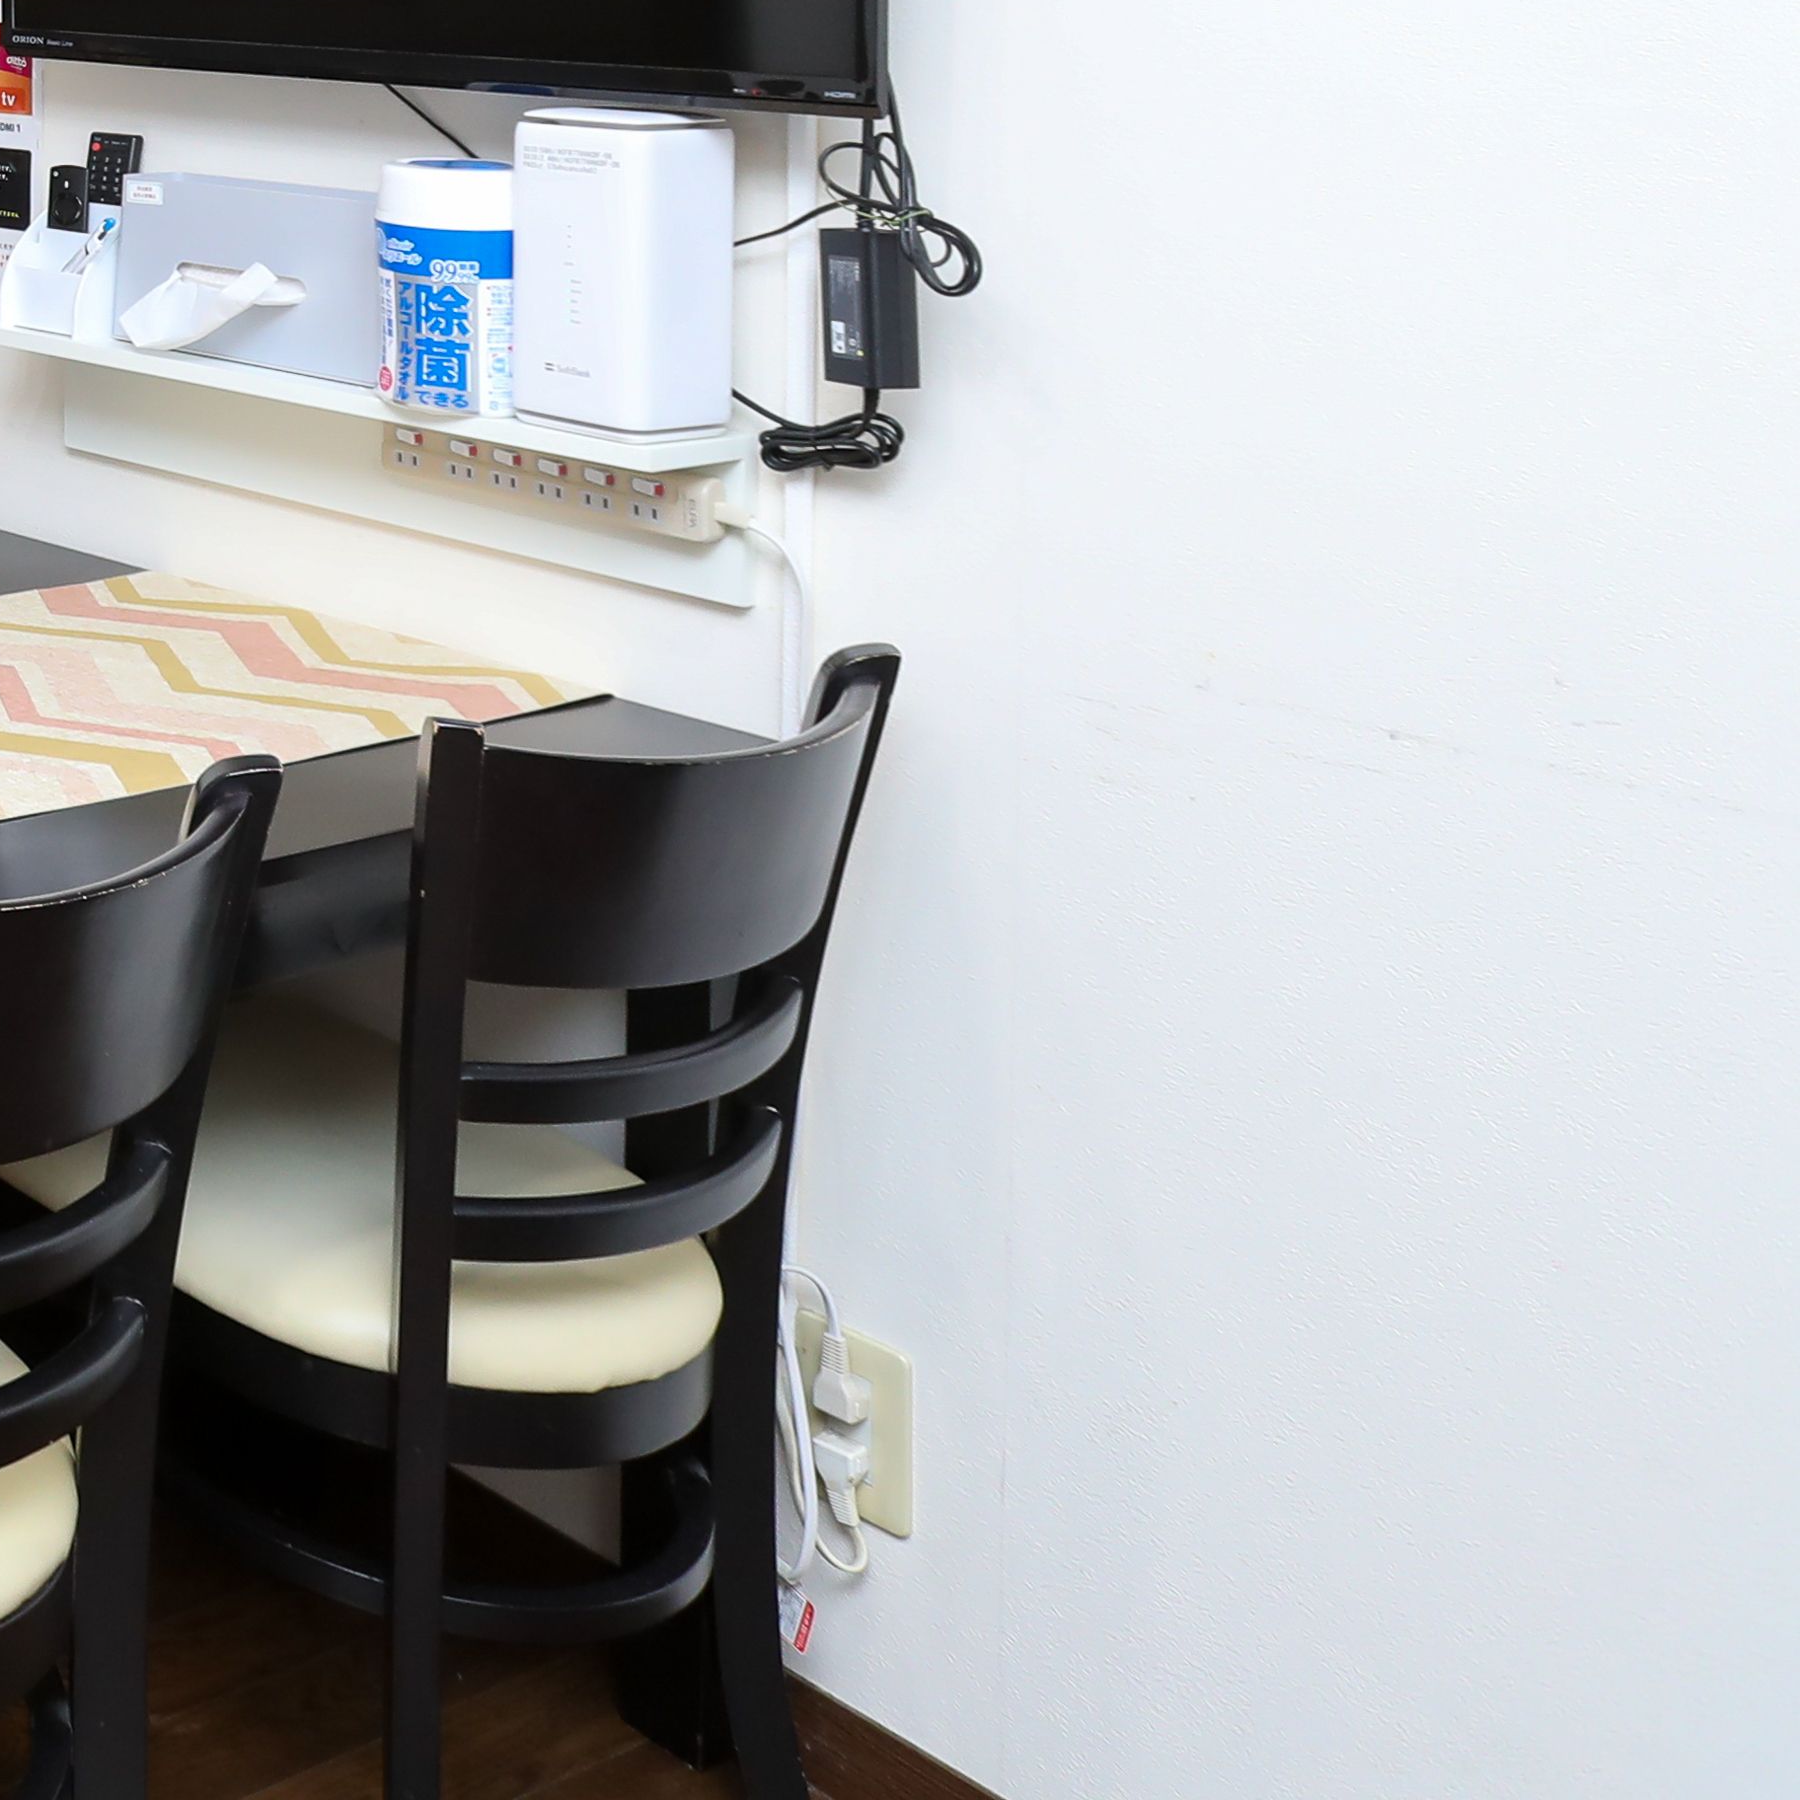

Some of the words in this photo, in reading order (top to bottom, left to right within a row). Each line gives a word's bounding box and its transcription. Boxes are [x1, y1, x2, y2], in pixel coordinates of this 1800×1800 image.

[12, 35, 44, 45] ORION
[1, 92, 16, 106] tv
[397, 280, 414, 400] アルコールタオル
[414, 283, 473, 392] 除菌
[415, 390, 470, 408] できる
